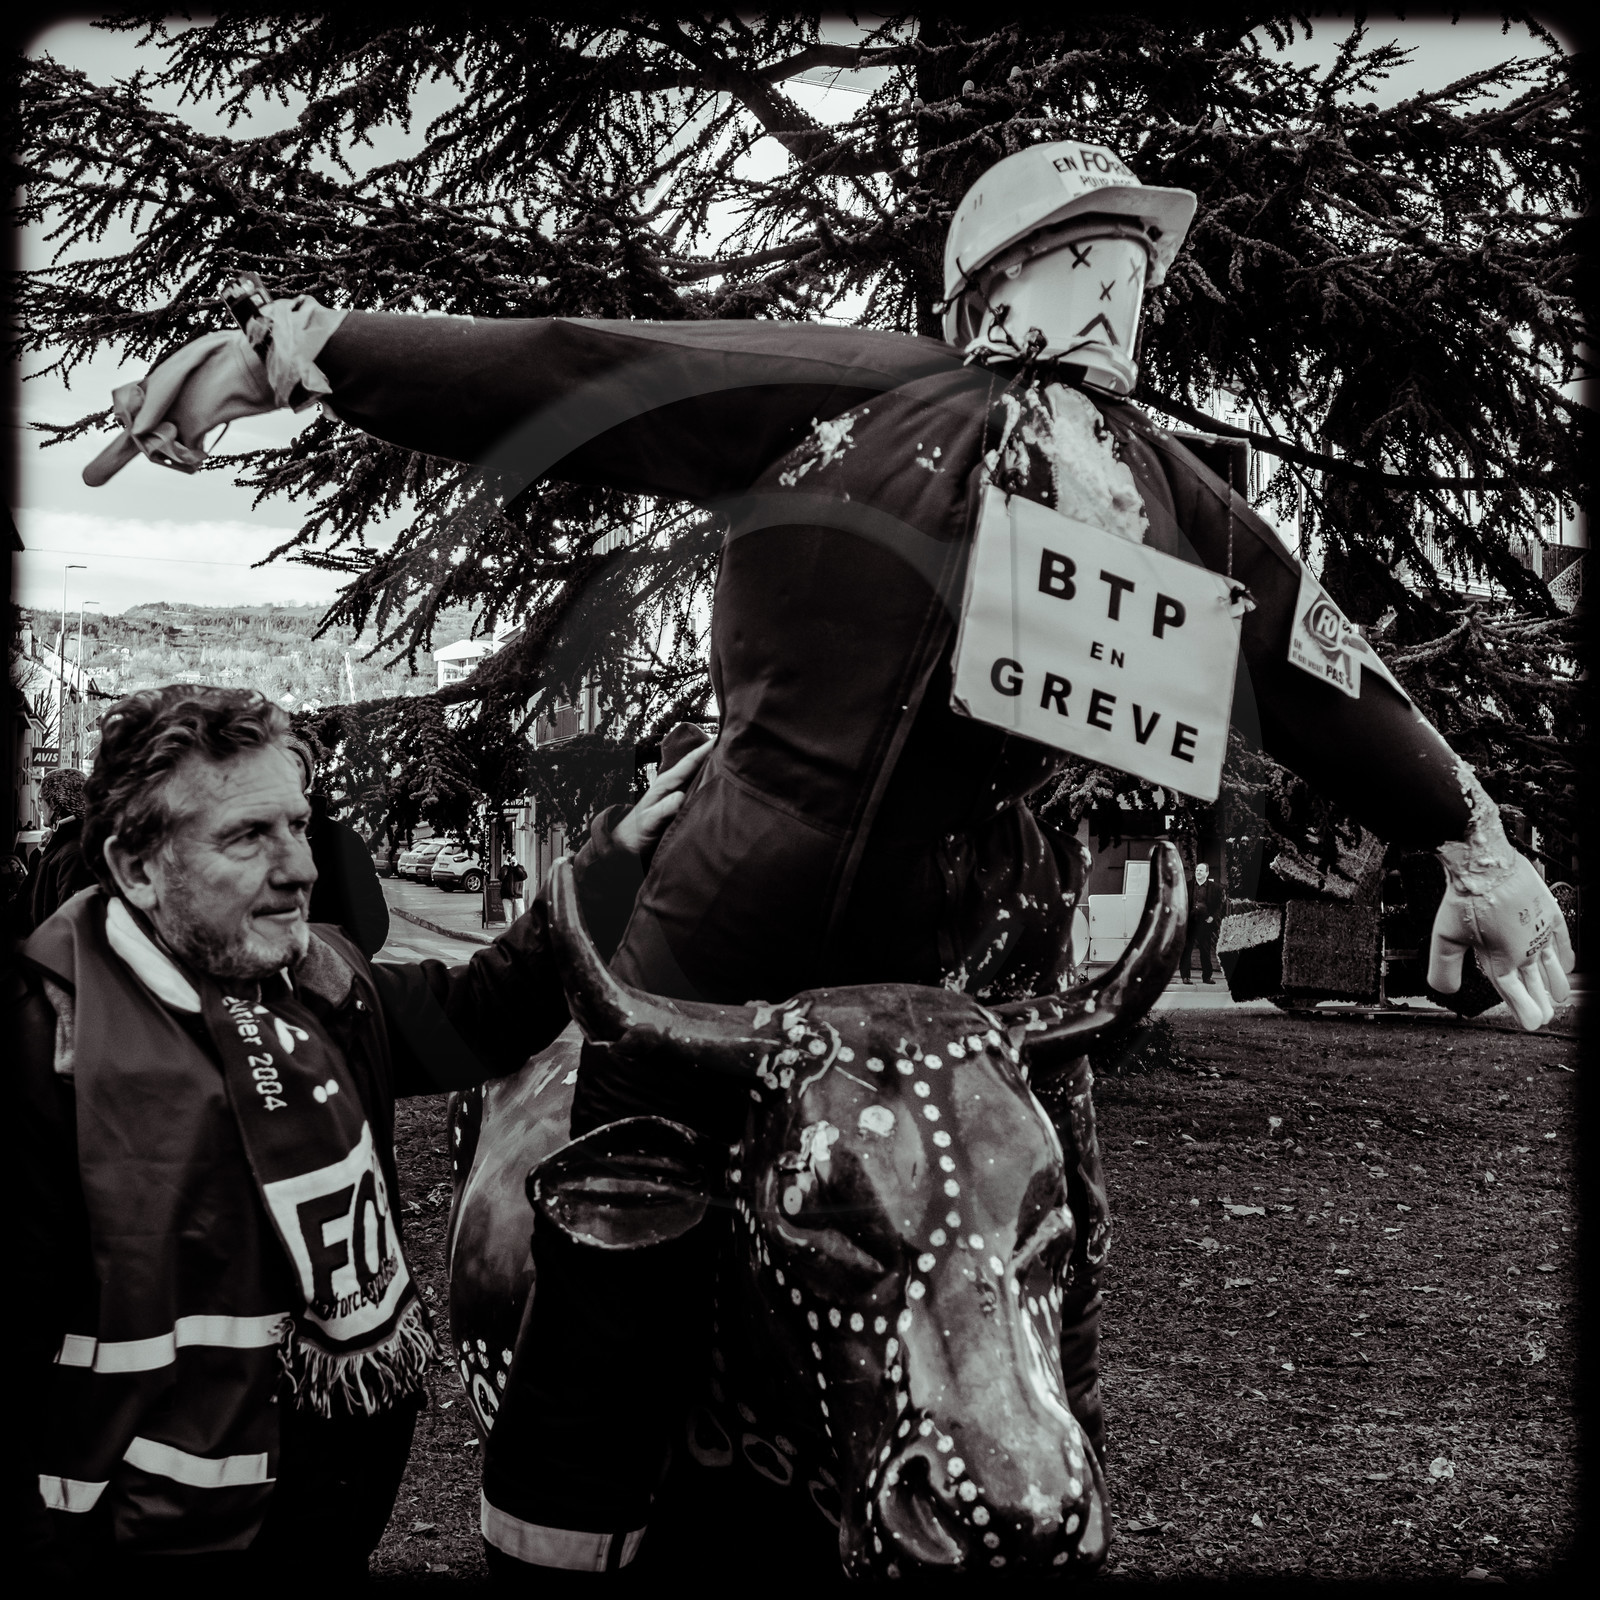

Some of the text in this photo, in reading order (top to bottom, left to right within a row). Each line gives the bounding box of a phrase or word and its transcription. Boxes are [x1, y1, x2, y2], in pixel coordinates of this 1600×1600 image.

[1053, 156, 1078, 173] EN
[1038, 547, 1187, 640] BTP
[1316, 607, 1339, 639] FO
[1089, 640, 1125, 669] EN
[1326, 664, 1346, 685] PAS
[990, 657, 1199, 764] GREVE
[33, 752, 59, 762] AVIS
[248, 1053, 288, 1111] 2004
[296, 1168, 388, 1306] FO
